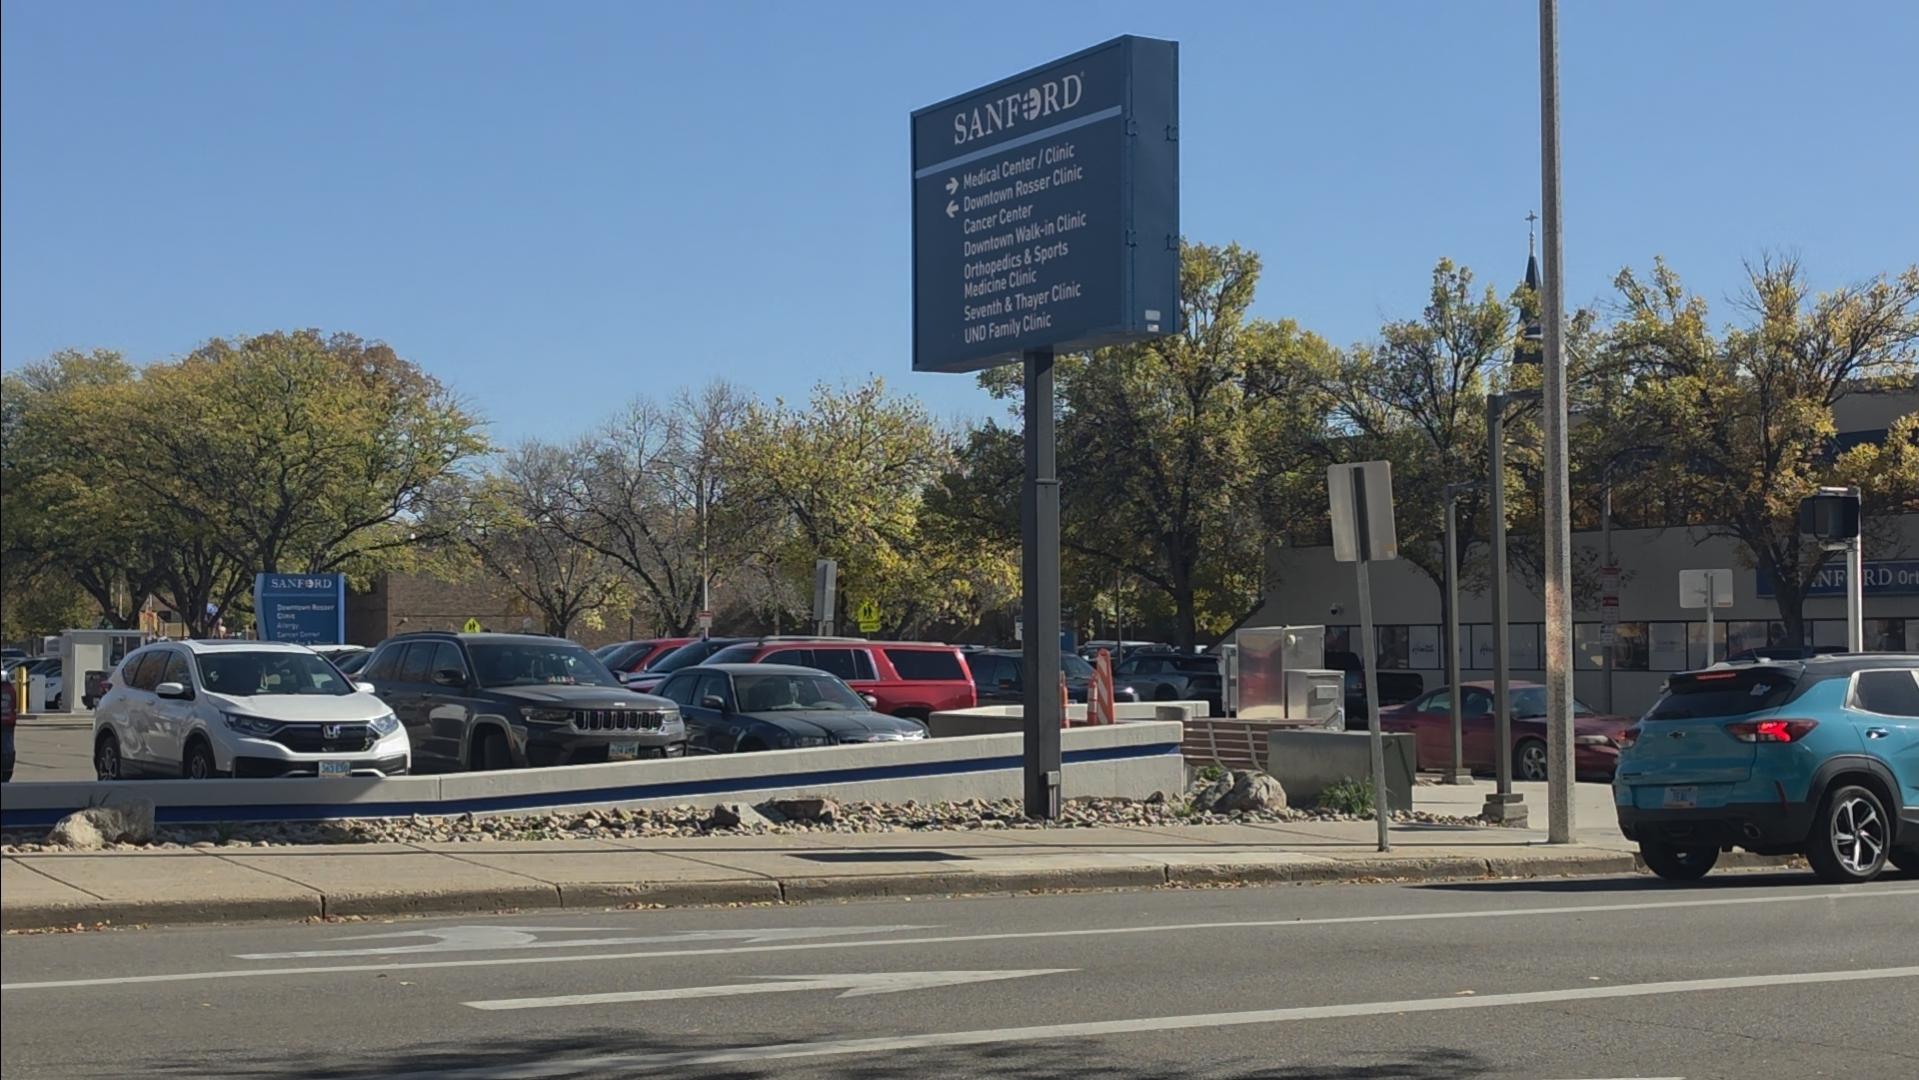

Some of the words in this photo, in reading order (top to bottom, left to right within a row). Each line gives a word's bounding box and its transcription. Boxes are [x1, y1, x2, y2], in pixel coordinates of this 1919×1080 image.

[954, 74, 1083, 145] SANFORD
[964, 164, 1001, 190] Medical
[1002, 156, 1036, 178] Center
[1037, 149, 1044, 169] /
[1045, 142, 1075, 165] Clinic
[964, 188, 1014, 212] Downtown
[1015, 176, 1051, 198] Rosser
[1053, 165, 1083, 187] Clinic
[964, 214, 998, 235] Cancer
[999, 204, 1034, 225] Center
[964, 234, 1014, 257] Downtown
[1015, 220, 1055, 244] Walk-in
[1057, 211, 1087, 233] Clinic
[964, 253, 1022, 280] Orthopedics
[1023, 249, 1033, 265] &
[1034, 242, 1069, 265] Sports
[964, 277, 1007, 299] Medicine
[1009, 267, 1037, 288] Clinic
[964, 299, 1003, 321] Seventh
[1004, 296, 1013, 313] &
[1014, 290, 1050, 311] Thayer
[1052, 281, 1081, 302] Clinic
[964, 324, 987, 344] UND
[988, 318, 1021, 338] Family
[1023, 312, 1052, 332] Clinic
[271, 578, 332, 589] SANFORD
